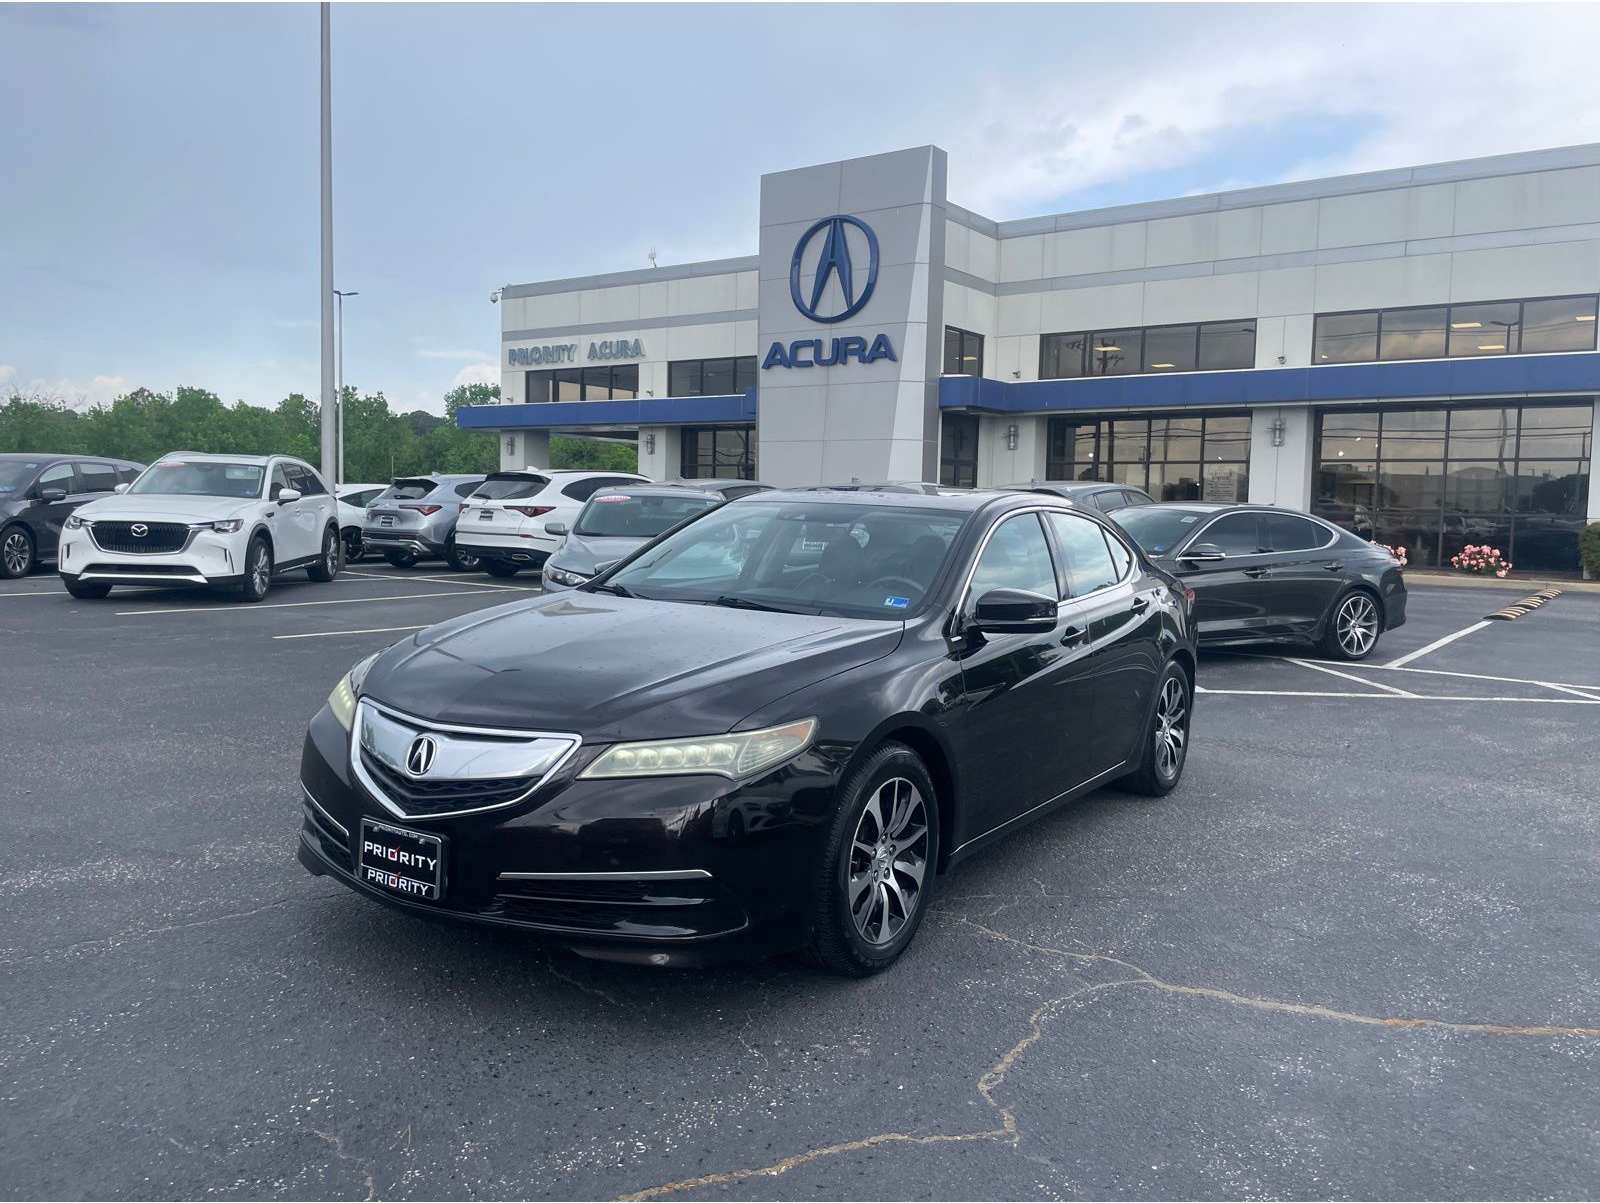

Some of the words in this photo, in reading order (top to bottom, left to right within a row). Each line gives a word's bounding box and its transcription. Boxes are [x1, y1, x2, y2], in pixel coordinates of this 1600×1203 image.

[508, 344, 577, 366] PRIORITY
[588, 338, 646, 360] ACURA
[761, 334, 897, 369] ACURA
[364, 841, 437, 870] PRIORITY
[367, 870, 429, 896] PRIORITY
